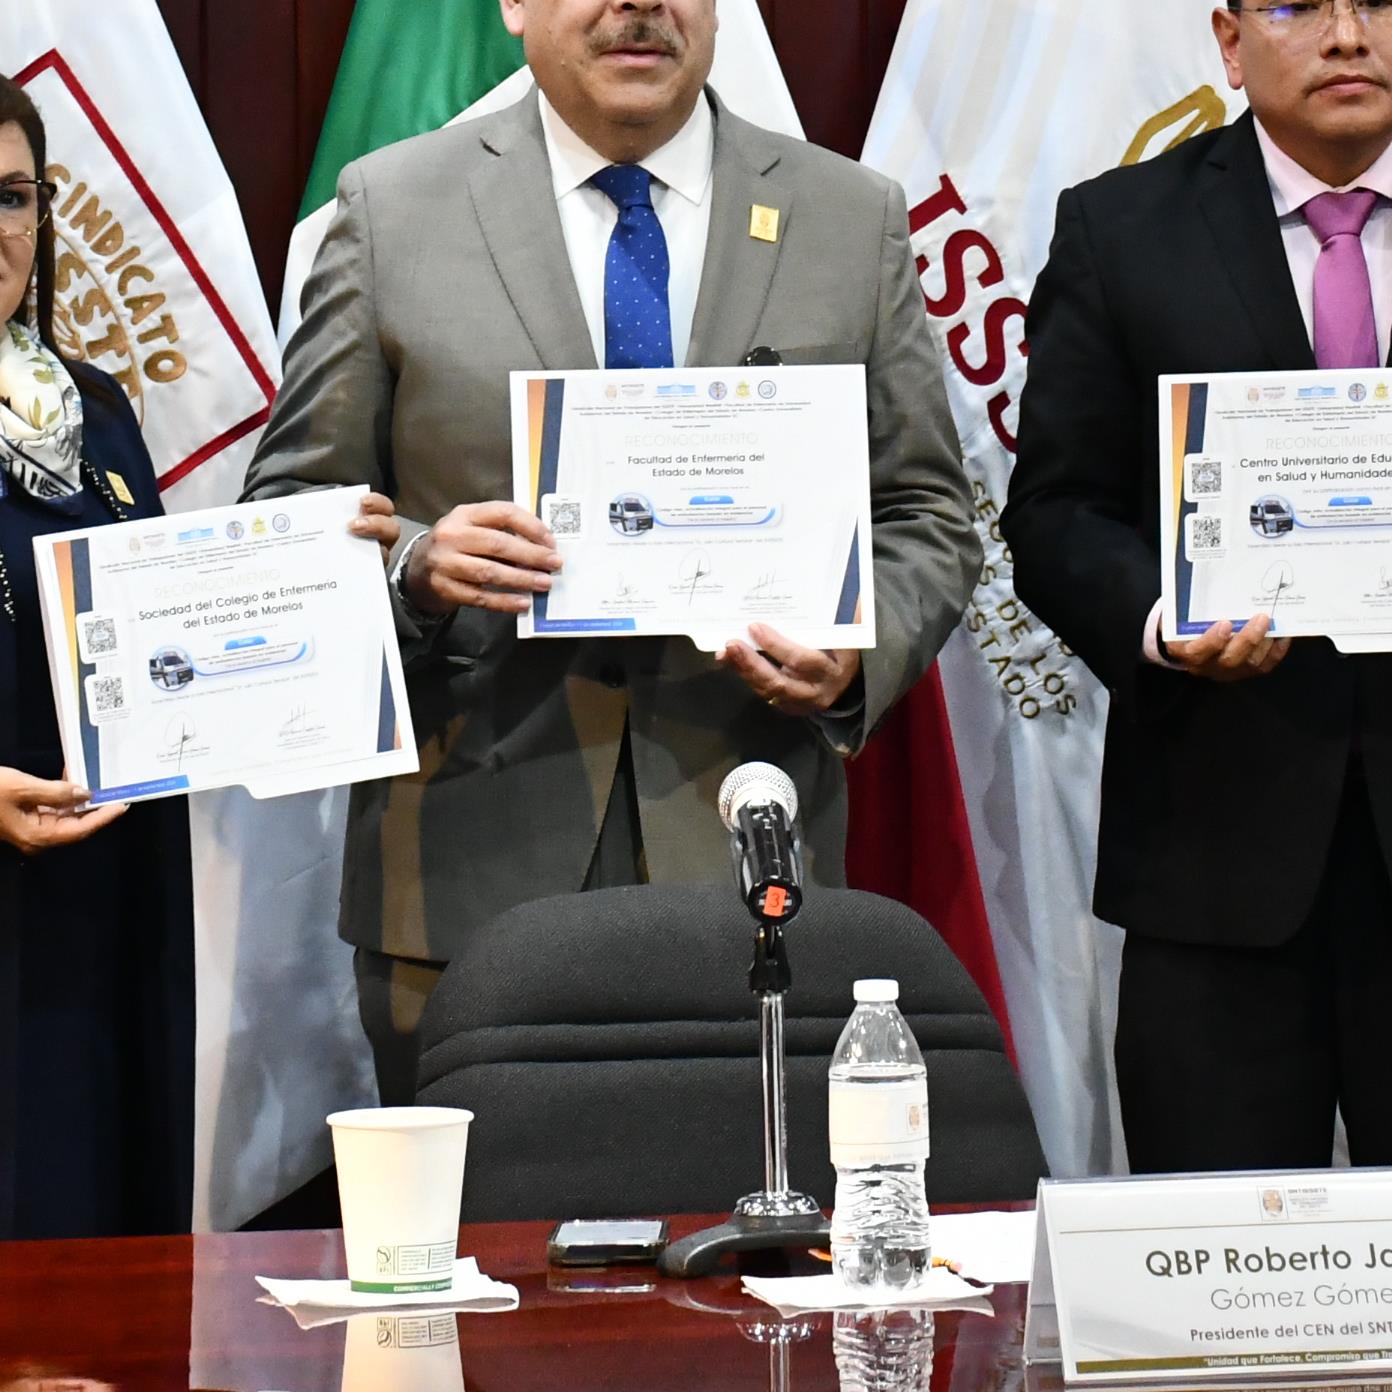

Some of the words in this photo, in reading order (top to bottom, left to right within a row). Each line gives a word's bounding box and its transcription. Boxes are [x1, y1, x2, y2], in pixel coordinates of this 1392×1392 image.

[627, 455, 672, 465] Facultad
[675, 454, 689, 464] de
[749, 452, 765, 462] del
[1240, 458, 1278, 468] Centro
[1281, 455, 1349, 467] Universitario
[1352, 454, 1368, 465] de
[652, 467, 686, 477] Estado
[689, 466, 702, 476] de
[705, 465, 744, 476] Morelos
[1257, 473, 1272, 482] en
[1275, 471, 1307, 482] Salud
[1311, 473, 1317, 483] y
[138, 604, 192, 621] Sociedad
[195, 600, 213, 612] del
[215, 593, 259, 611] Colegio
[262, 588, 277, 600] de
[183, 617, 201, 629] del
[203, 612, 240, 626] Estado
[243, 607, 258, 618] de
[261, 601, 303, 616] Morelos
[967, 611, 1040, 719] STADO
[996, 599, 1033, 643] DE
[1029, 653, 1077, 715] LOS
[769, 893, 780, 908] 3
[1145, 1249, 1210, 1278] QBP
[1224, 1244, 1352, 1274] Roberto
[1210, 1286, 1306, 1310] Gómez
[1190, 1326, 1269, 1342] Presidente
[1275, 1325, 1298, 1338] del
[1303, 1323, 1335, 1337] CEN
[1340, 1322, 1363, 1336] del
[1241, 1357, 1258, 1366] que
[1362, 1351, 1379, 1361] que
